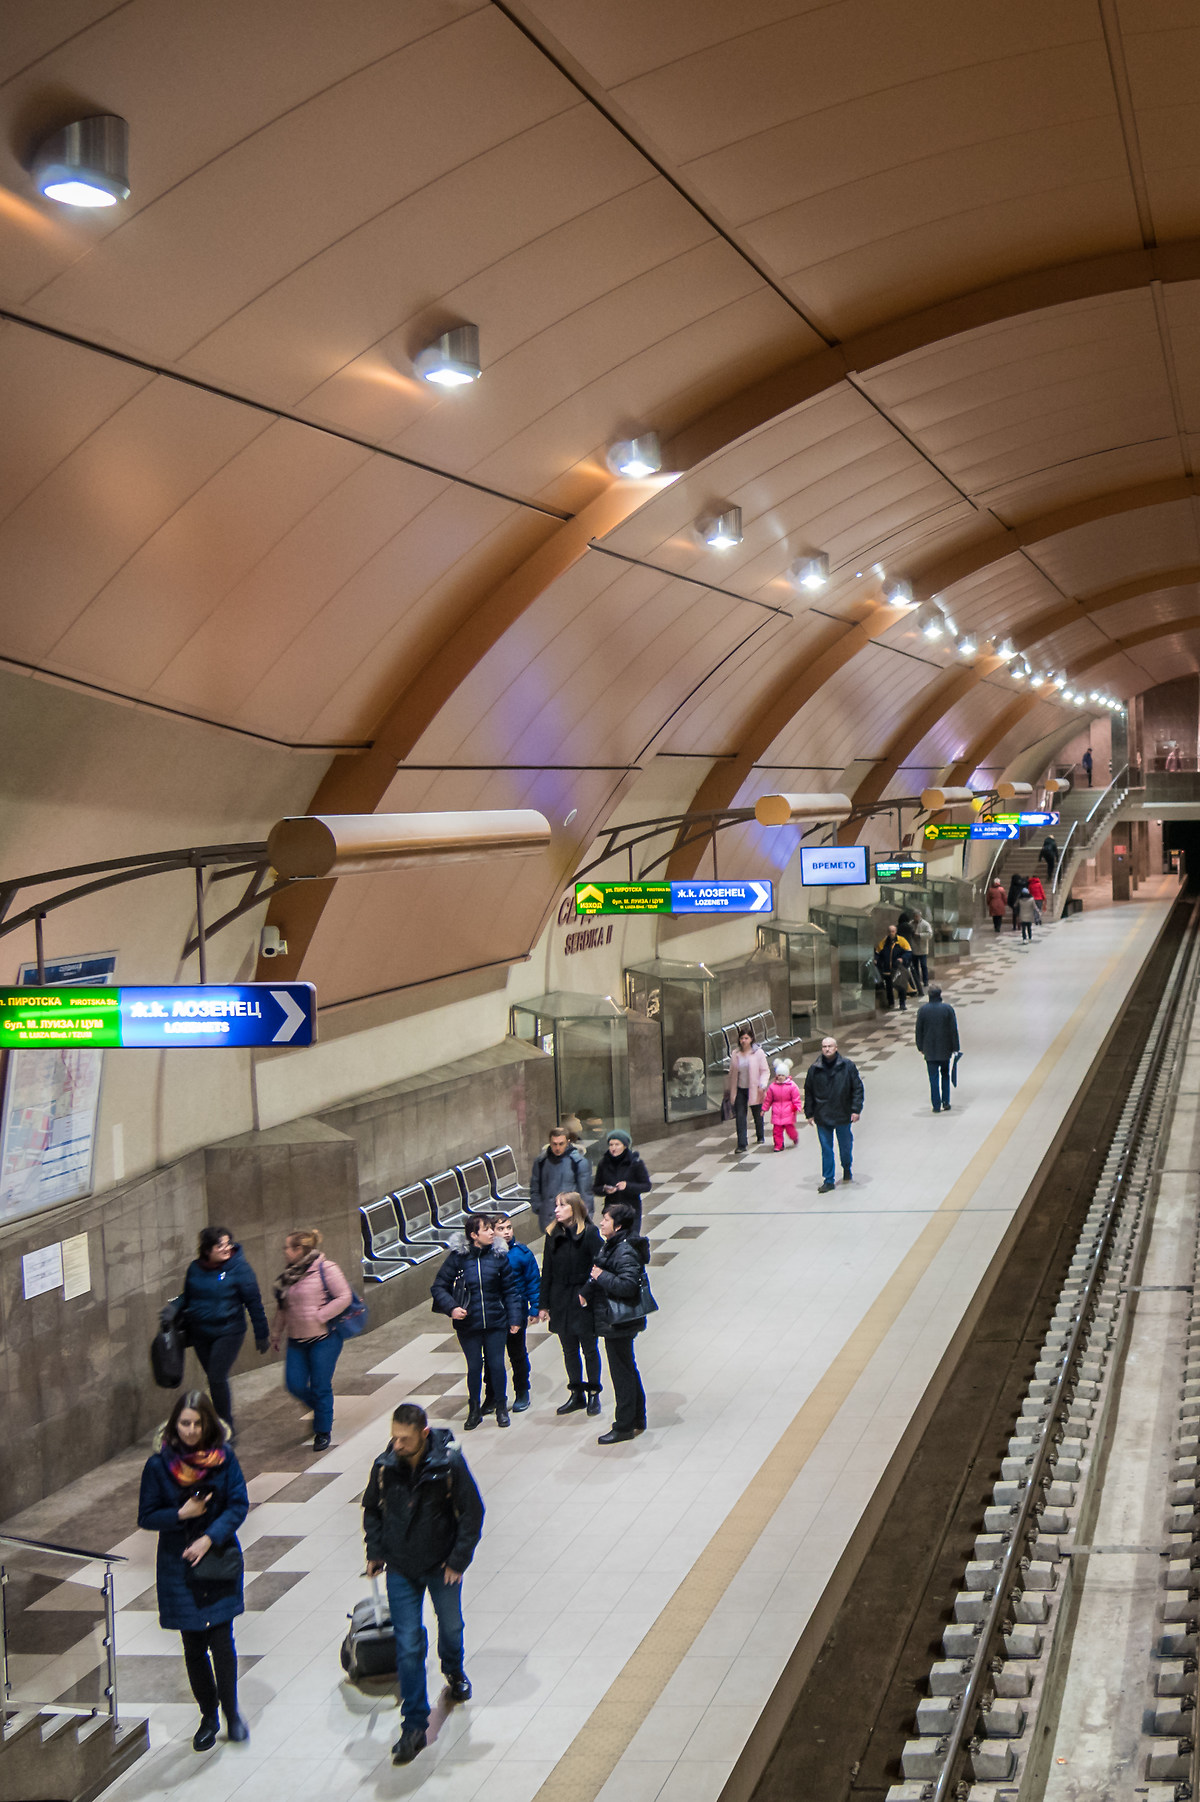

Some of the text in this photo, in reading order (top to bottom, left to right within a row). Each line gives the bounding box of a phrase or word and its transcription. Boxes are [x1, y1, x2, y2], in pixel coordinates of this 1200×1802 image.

[812, 861, 856, 870] ВРЕМЕТО
[699, 888, 746, 898] ЛОЗЕНЕЦ
[564, 926, 604, 956] SERDIKA
[8, 997, 62, 1006] ПИРОТСКА
[70, 998, 106, 1006] PIROTSKA
[172, 1001, 261, 1018] ЛОЗЕНЕЦ
[40, 1019, 74, 1029] ЛУИЗА
[81, 1019, 104, 1030] ЦУМ
